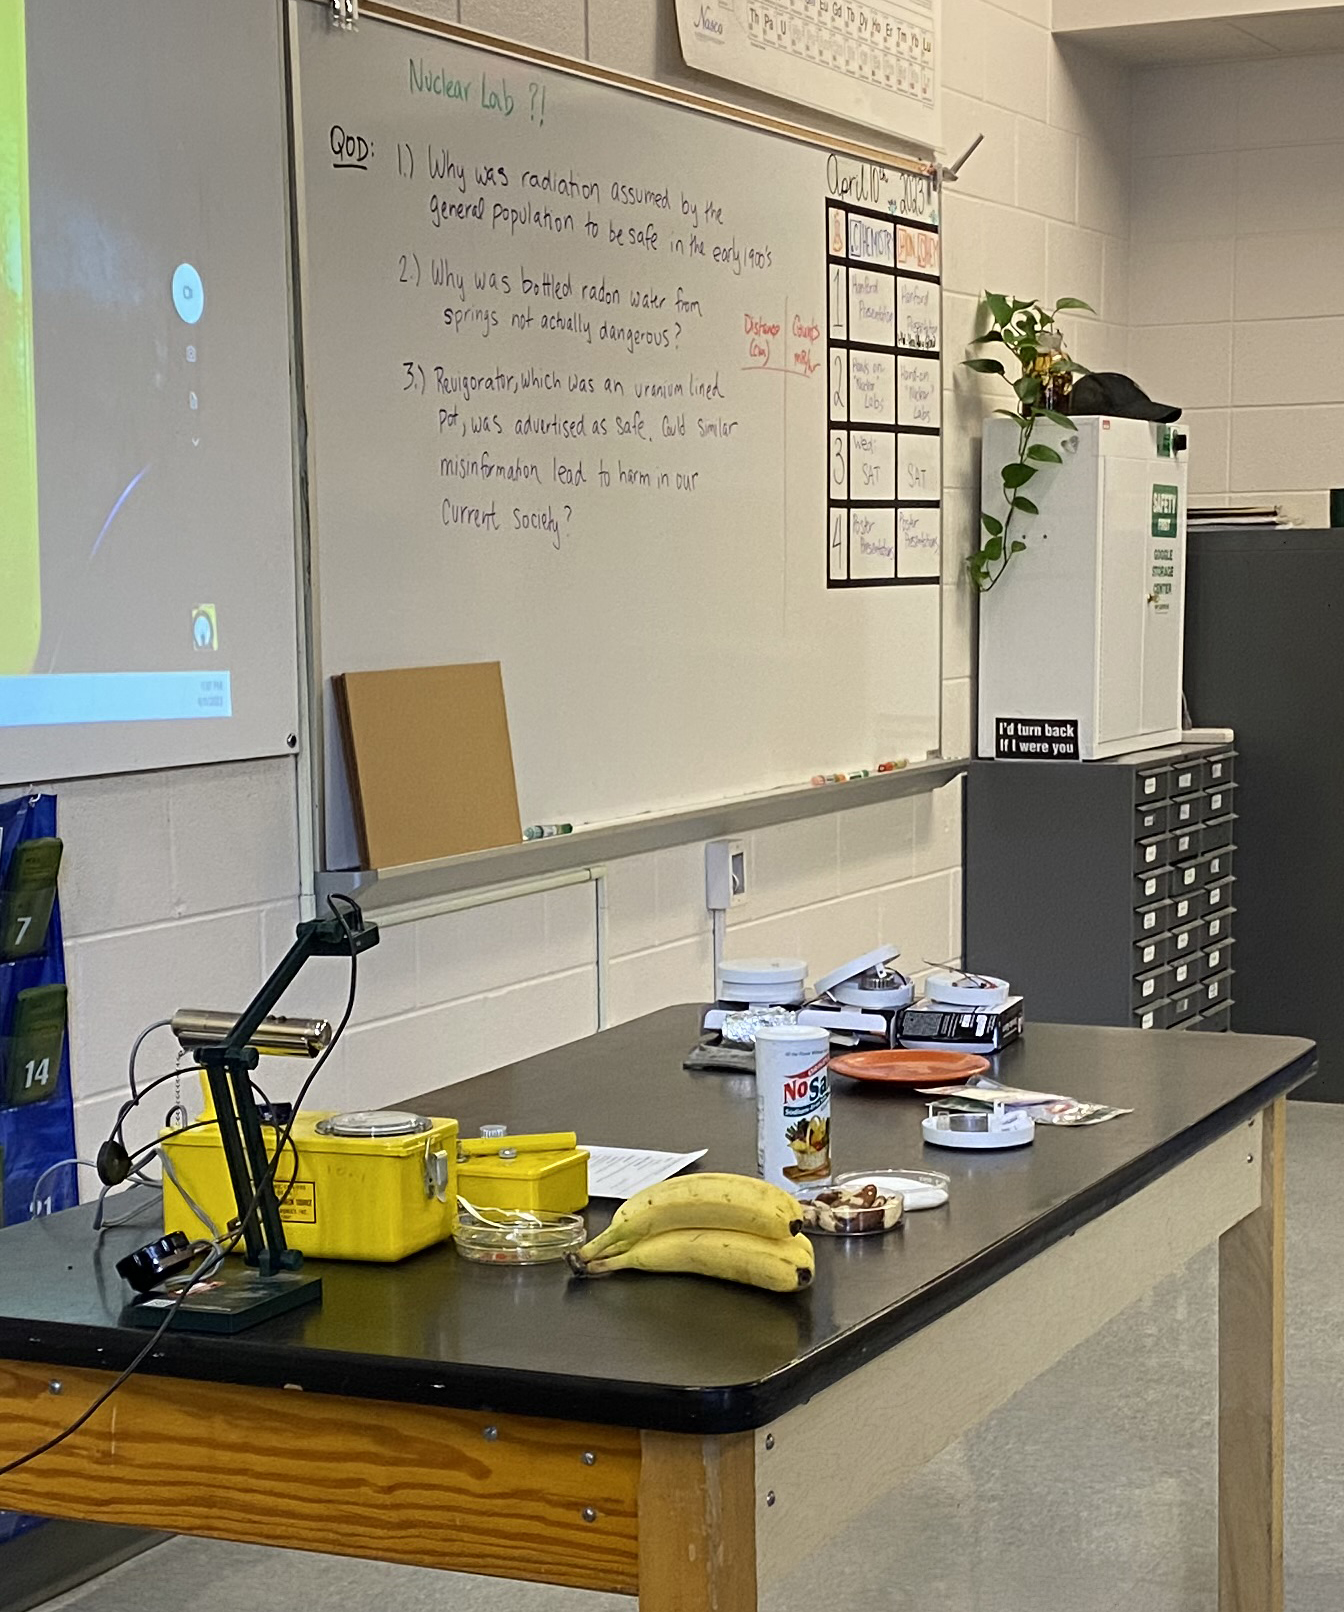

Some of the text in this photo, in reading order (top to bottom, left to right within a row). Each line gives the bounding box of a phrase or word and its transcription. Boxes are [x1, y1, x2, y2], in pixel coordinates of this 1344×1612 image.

[781, 20, 786, 35] U
[860, 12, 868, 32] Dy
[409, 58, 471, 101] Nuclear
[481, 72, 513, 116] Lab
[428, 144, 466, 193] Why
[475, 166, 509, 187] was
[521, 169, 600, 203] radiation
[611, 181, 671, 210] assumed
[681, 191, 698, 228] by
[704, 200, 723, 225] the
[827, 154, 868, 200] April
[430, 194, 485, 228] general
[492, 201, 574, 236] population
[585, 211, 599, 238] to
[609, 220, 624, 246] be
[629, 223, 658, 251] safe
[670, 231, 684, 256] in
[690, 233, 706, 257] the
[713, 235, 740, 276] early
[399, 253, 703, 317] 2.) Why was bottled radon water from
[833, 269, 843, 327] 1
[444, 305, 499, 338] springs
[511, 306, 534, 331] not
[541, 311, 592, 344] actually
[568, 373, 595, 393] was
[604, 377, 624, 396] an
[634, 381, 683, 400] uranium
[690, 371, 725, 400] lined
[834, 355, 845, 408] 2
[471, 414, 503, 434] was
[515, 413, 586, 439] advertised
[592, 418, 607, 435] as
[440, 451, 699, 492] misinformation lead to harm in our
[834, 437, 845, 485] 3
[862, 463, 880, 486] SAT
[908, 463, 926, 489] SAT
[832, 514, 842, 570] 4
[999, 722, 1074, 737] I'd turn back
[1000, 738, 1074, 756] If I were you
[14, 917, 32, 945] 7
[25, 1058, 51, 1089] 14
[784, 1075, 828, 1104] NoSa
